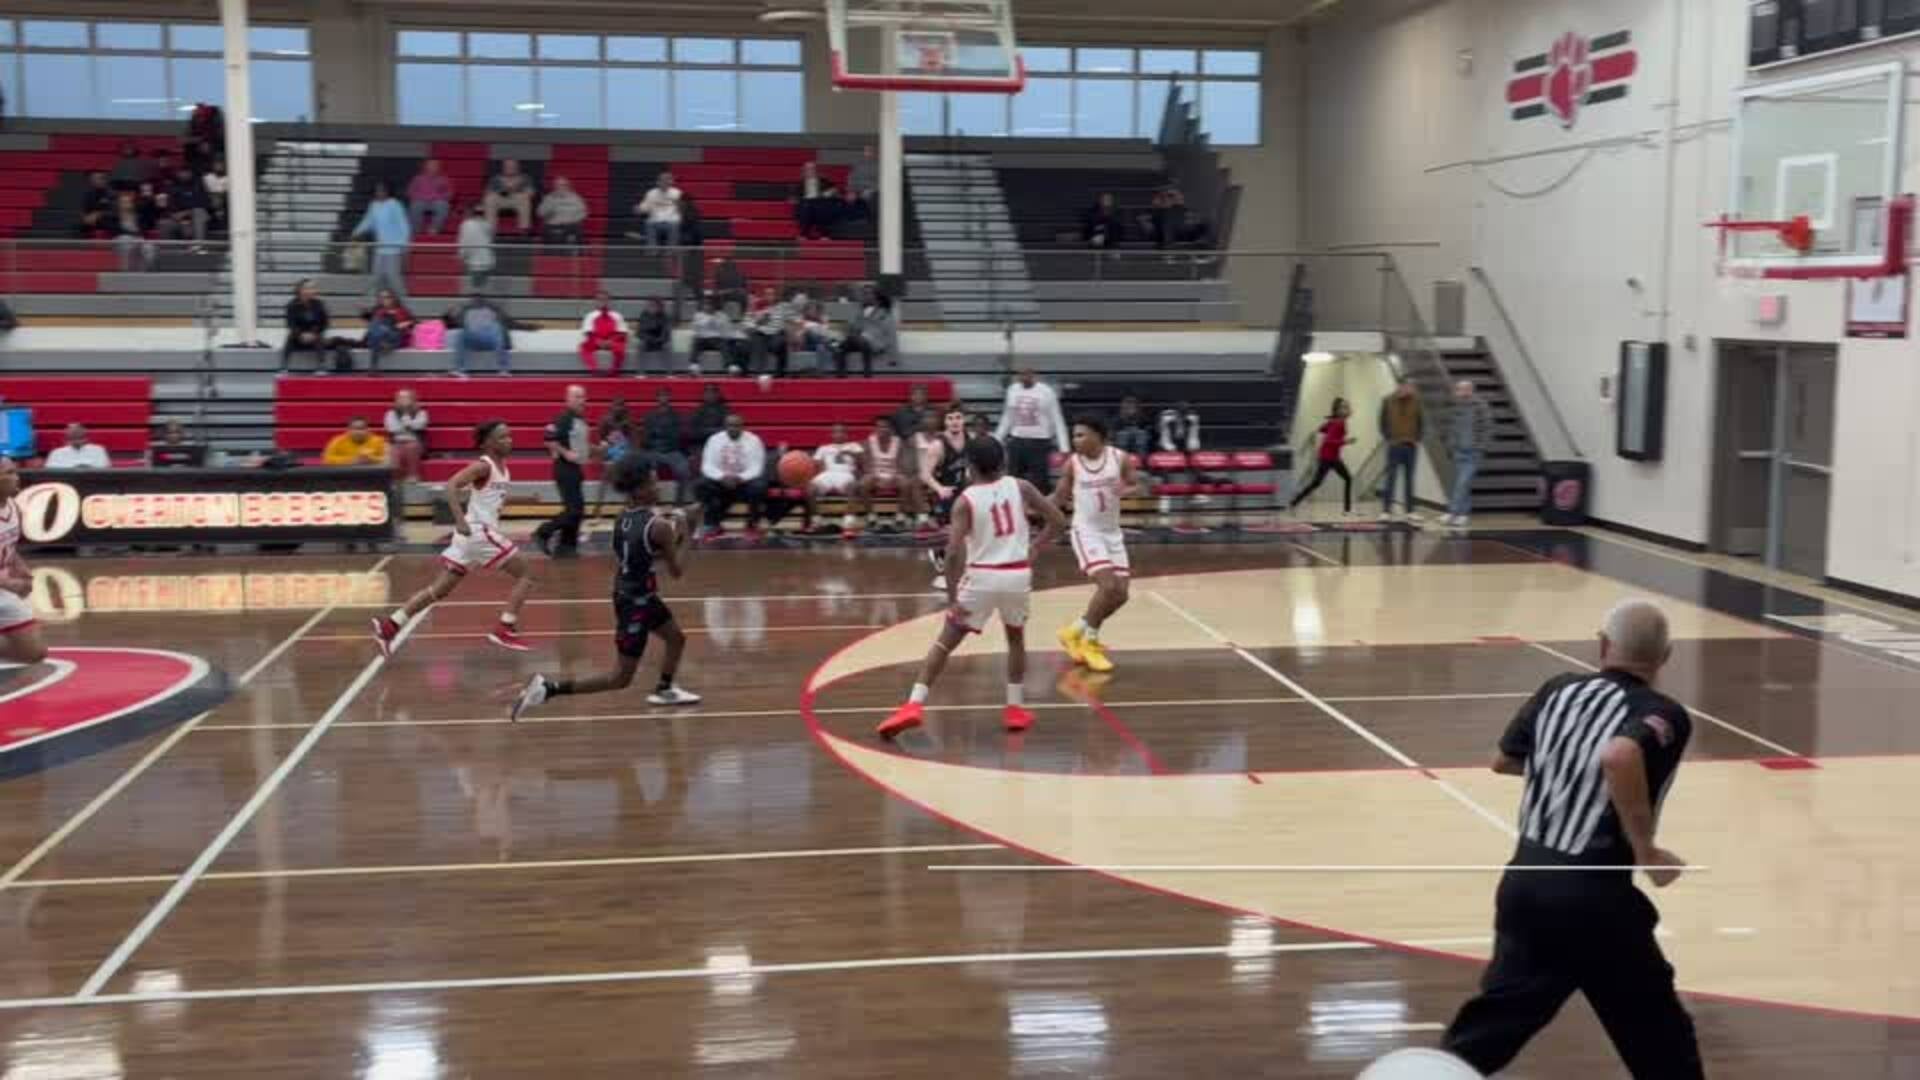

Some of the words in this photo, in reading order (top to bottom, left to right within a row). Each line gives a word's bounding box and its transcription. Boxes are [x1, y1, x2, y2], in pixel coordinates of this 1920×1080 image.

[240, 492, 388, 526] BOBCATS
[991, 499, 1016, 538] 11
[1096, 491, 1107, 513] 1
